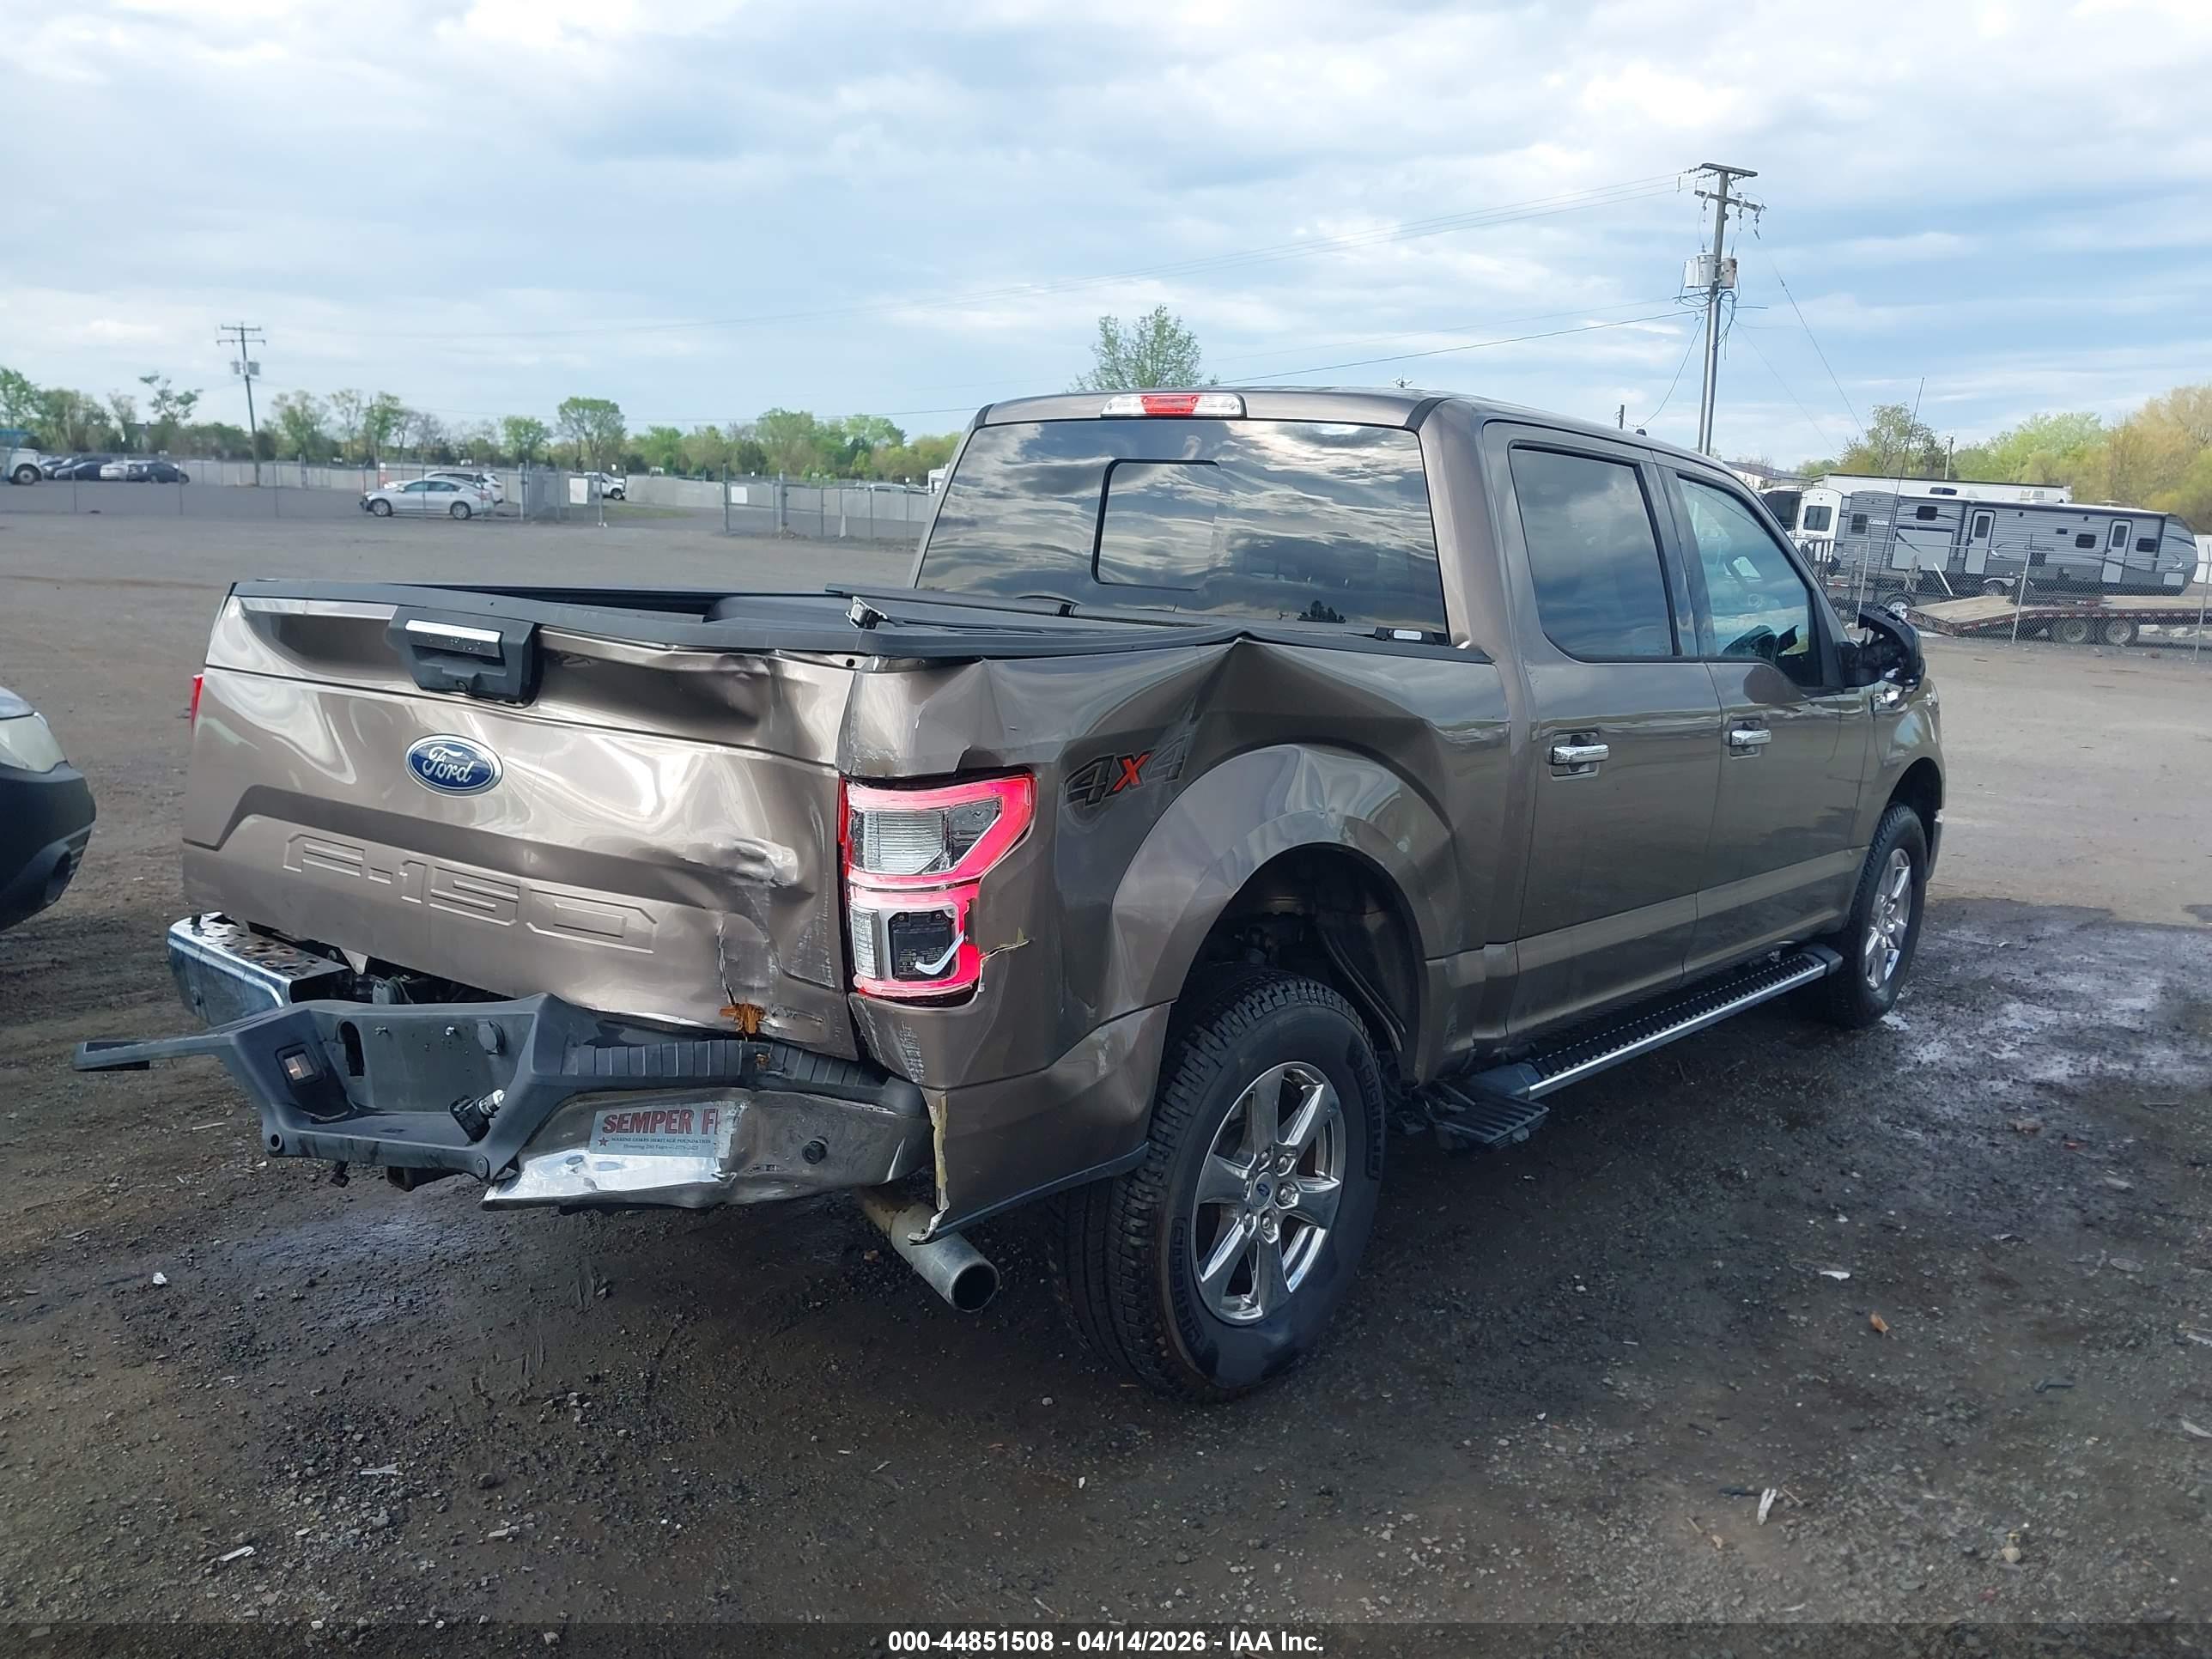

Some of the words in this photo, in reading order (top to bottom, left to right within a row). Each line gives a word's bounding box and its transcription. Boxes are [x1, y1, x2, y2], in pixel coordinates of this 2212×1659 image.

[422, 745, 475, 783] Ford
[283, 831, 658, 955] F-150
[602, 1109, 695, 1134] SEMPER
